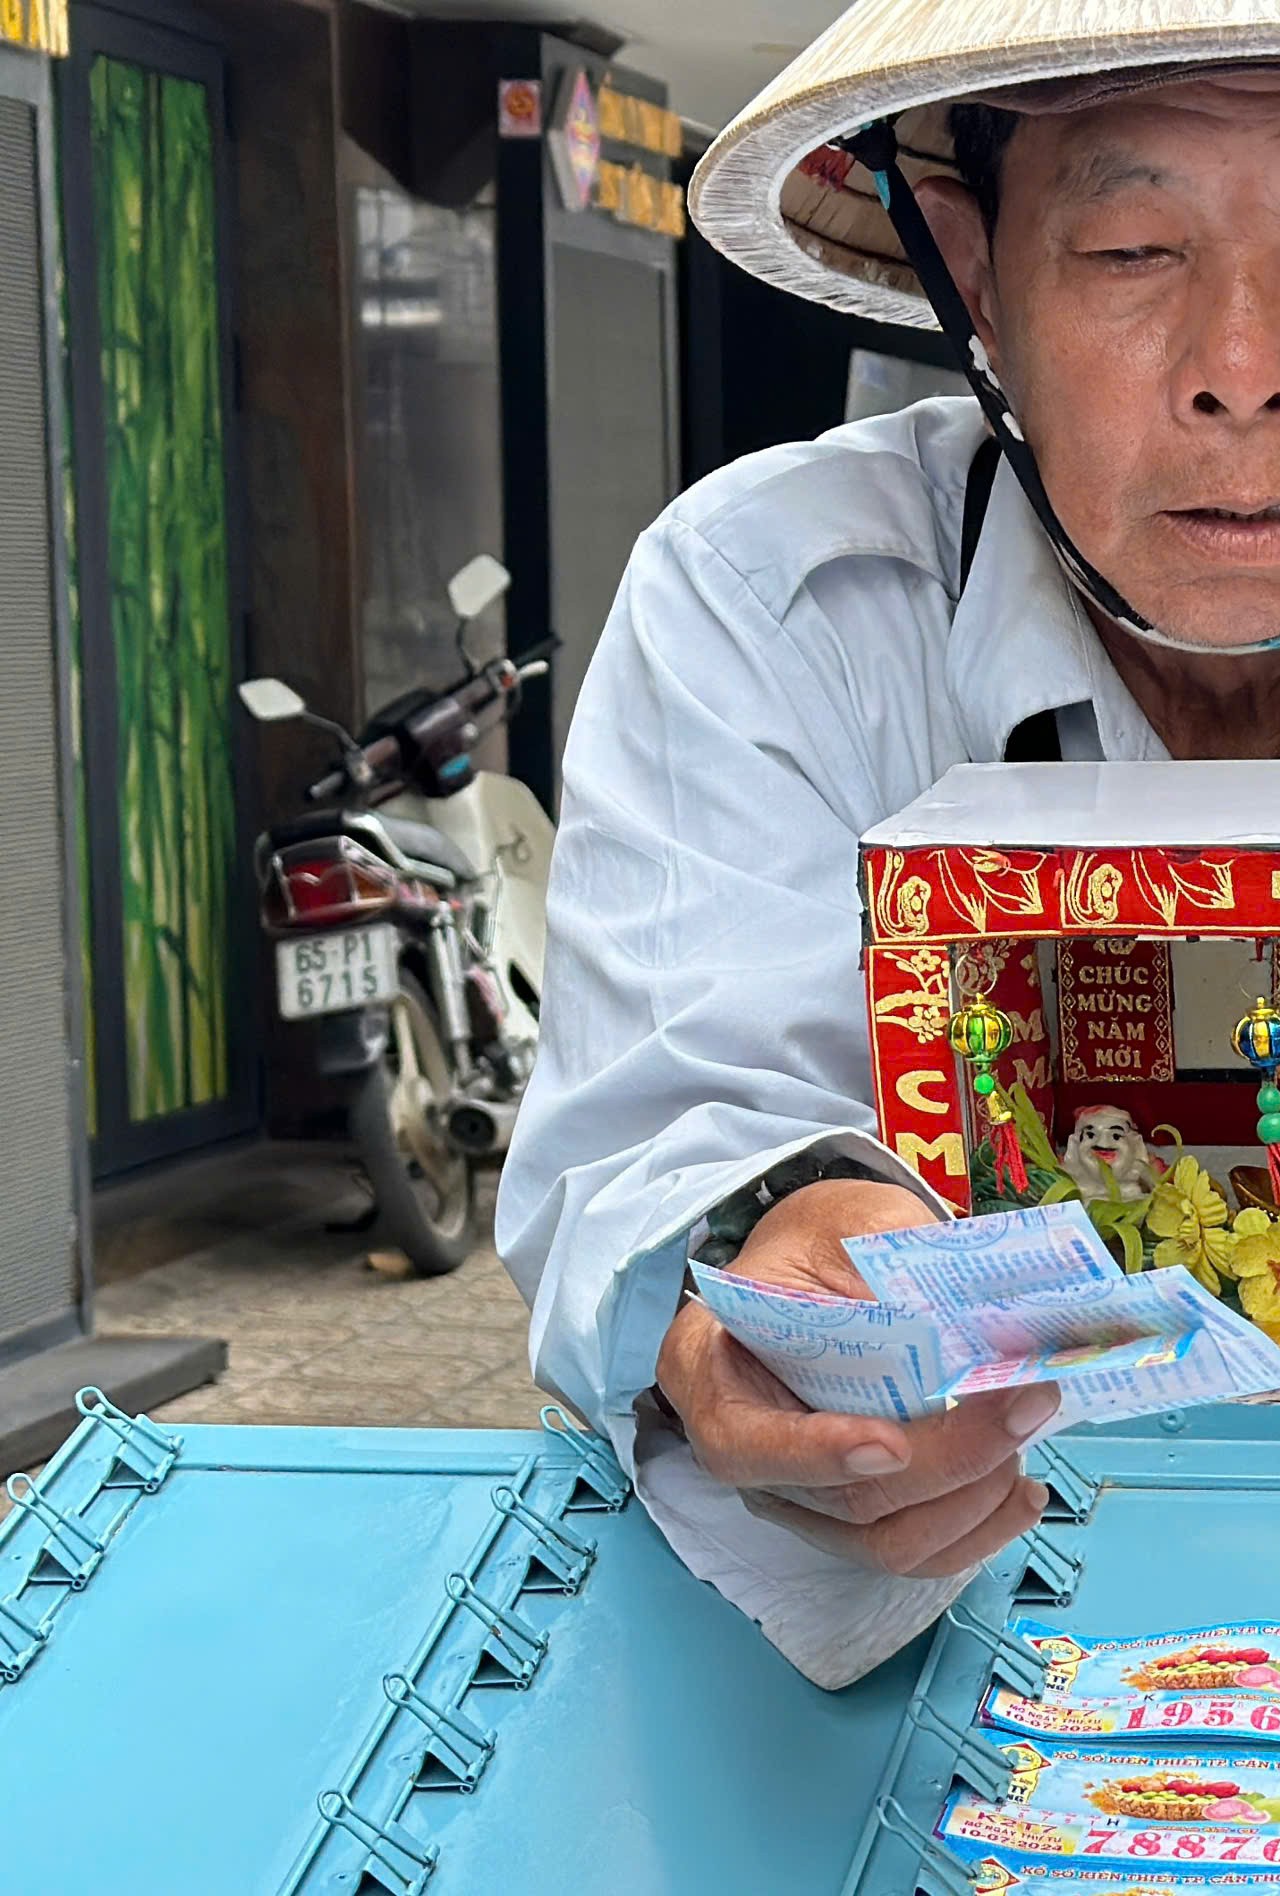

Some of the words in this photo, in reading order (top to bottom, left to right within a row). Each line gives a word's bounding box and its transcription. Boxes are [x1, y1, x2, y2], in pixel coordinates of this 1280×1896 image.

[1078, 960, 1150, 985] CHÚC
[297, 966, 378, 1008] 6715
[1077, 988, 1153, 1012] MỪNG
[1087, 1016, 1146, 1041] NĂM
[1094, 1044, 1142, 1069] MỚI
[1005, 1710, 1103, 1733] 10-07-2024
[977, 1811, 1058, 1834] K2T7
[959, 1827, 1064, 1852] 10-07-2024
